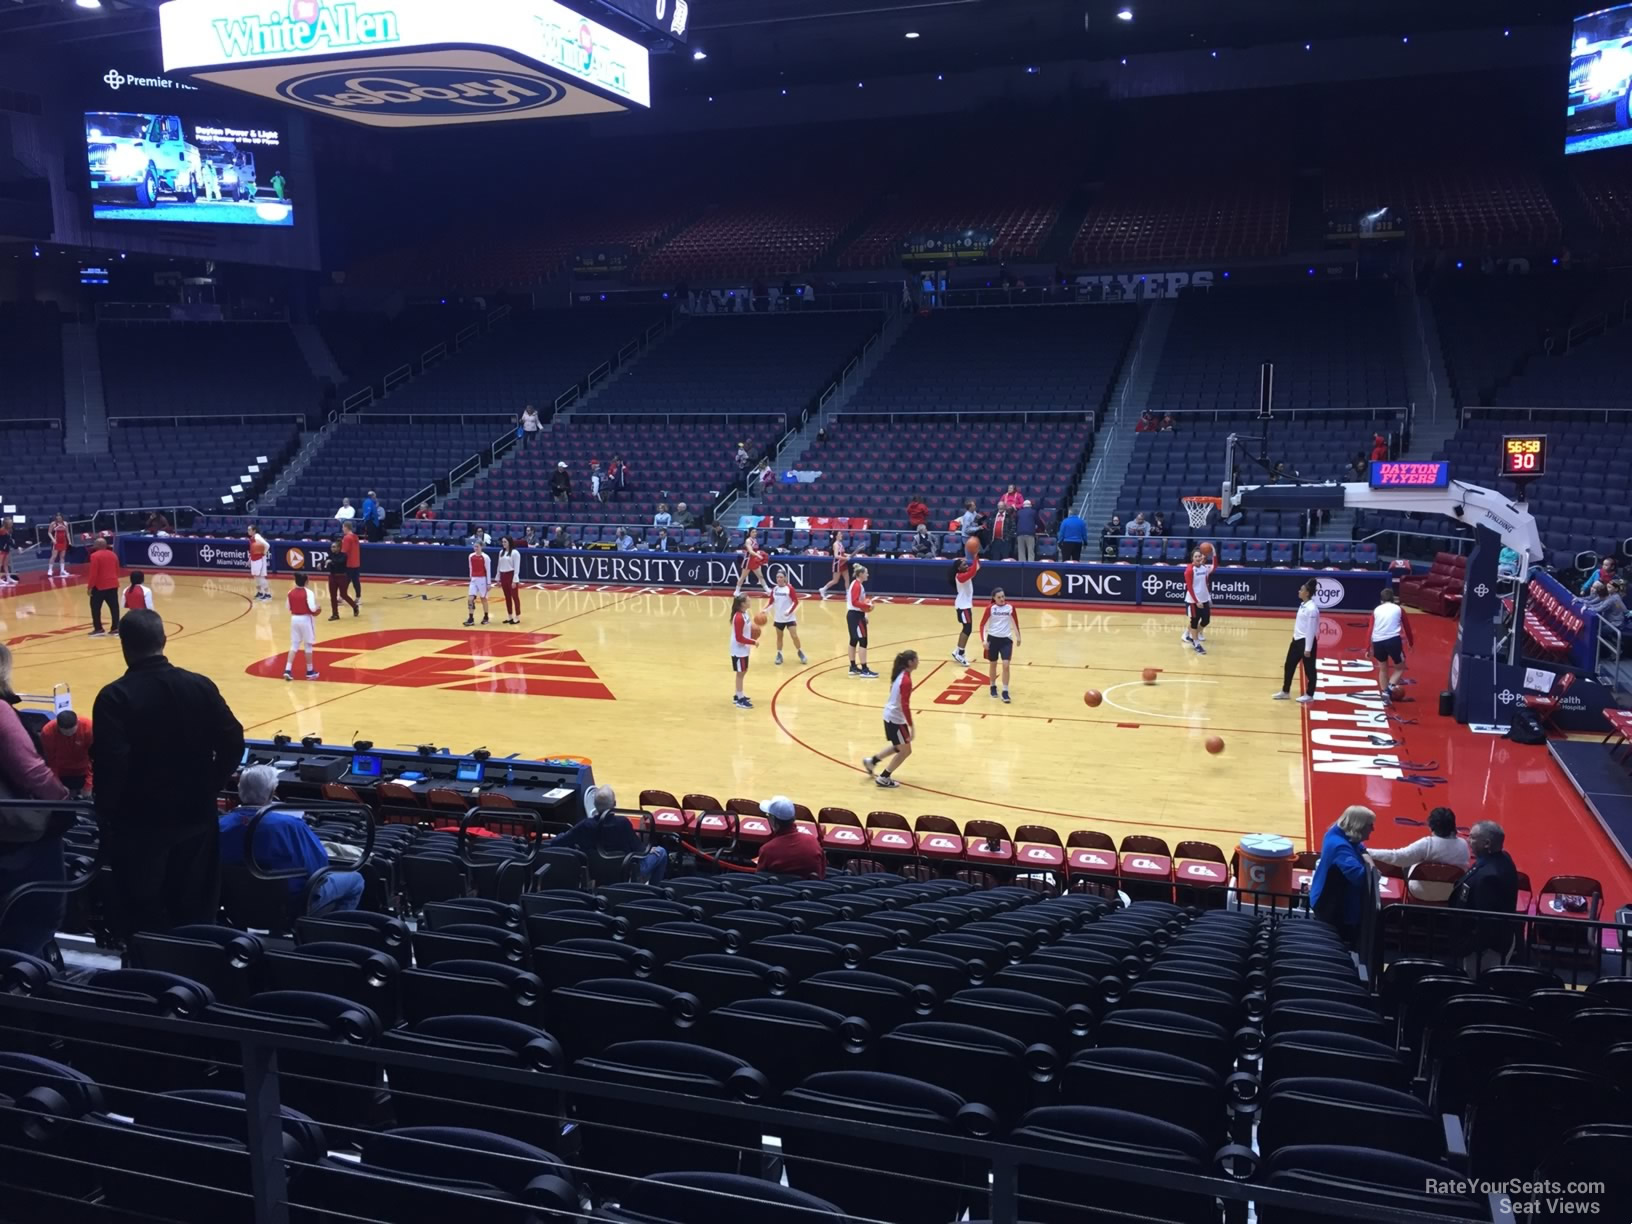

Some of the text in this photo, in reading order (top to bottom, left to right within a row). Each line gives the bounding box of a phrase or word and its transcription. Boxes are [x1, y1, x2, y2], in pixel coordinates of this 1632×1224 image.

[127, 74, 173, 88] Premier
[314, 78, 542, 107] Kroger
[1507, 441, 1541, 453] 56:58
[1379, 464, 1440, 473] DAYTON
[1513, 454, 1534, 469] 30
[1381, 474, 1437, 484] FLYERS
[1485, 510, 1513, 533] SPALDING
[150, 545, 170, 562] Kroger
[216, 549, 245, 559] Premier
[532, 555, 685, 582] UNIVERSITY
[688, 565, 700, 580] of
[1065, 574, 1121, 595] PNC
[1211, 581, 1250, 592] Health
[1225, 593, 1257, 602] Hospital
[1313, 582, 1340, 604] roger
[1249, 865, 1265, 883] G
